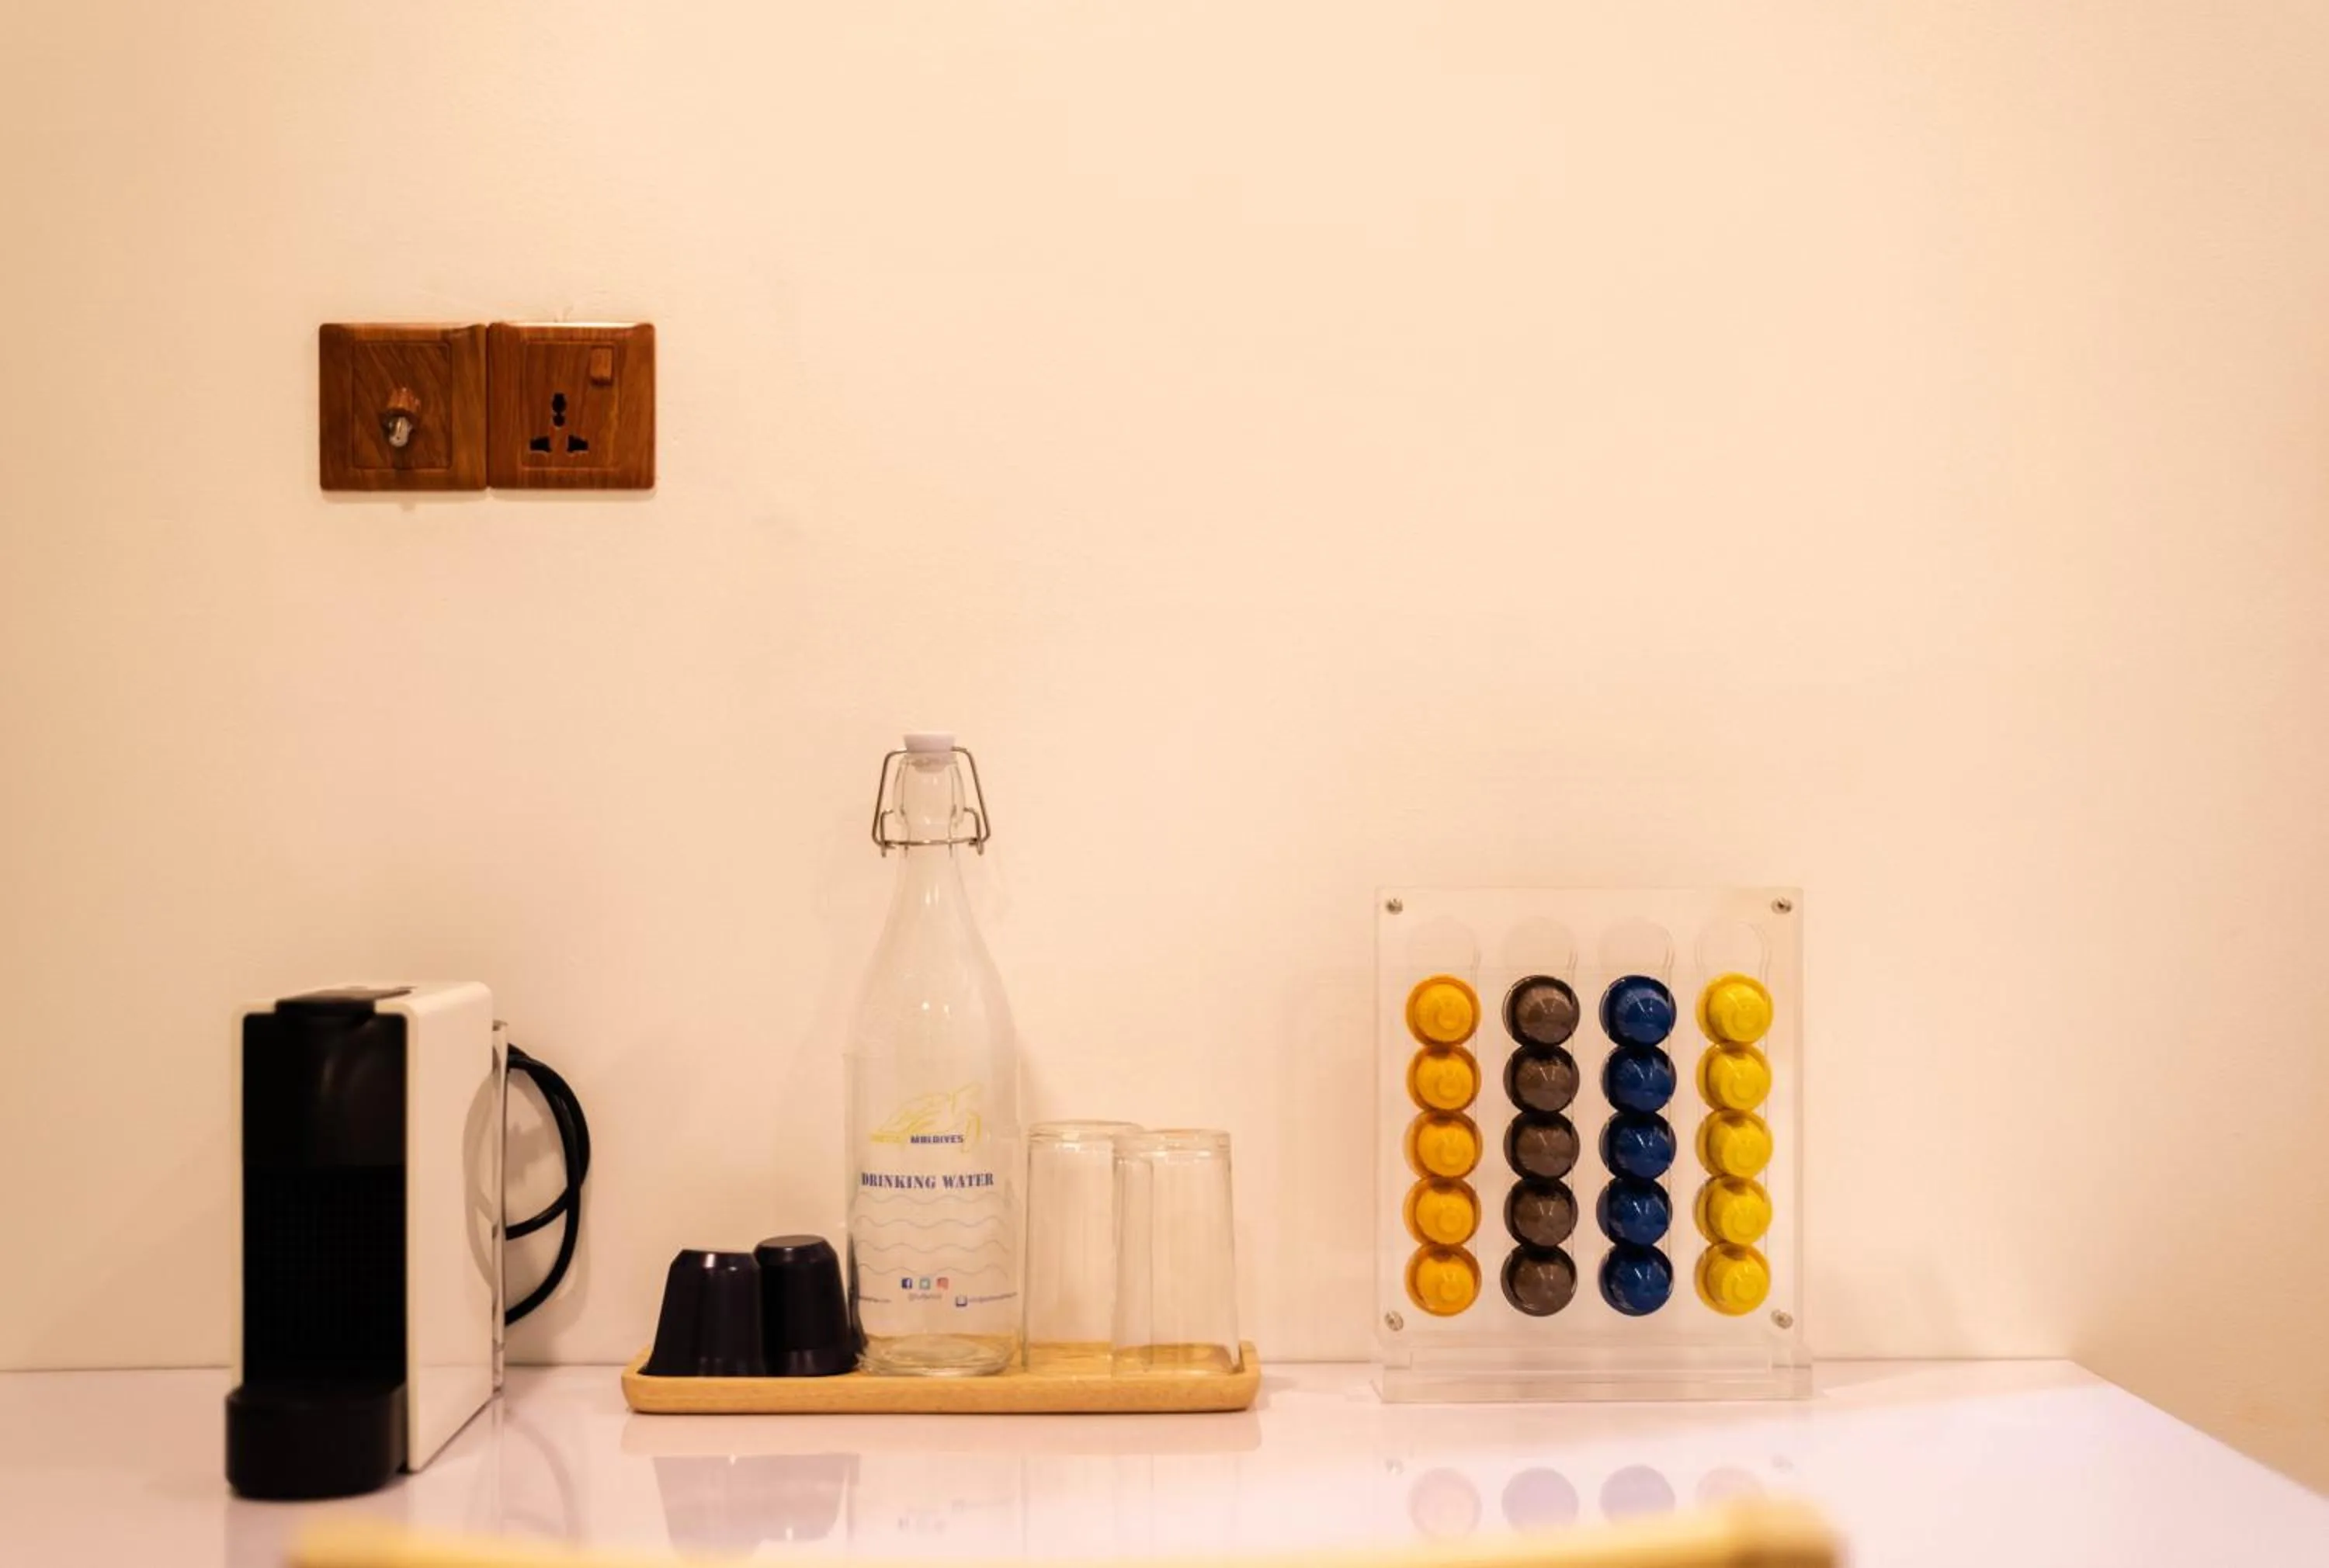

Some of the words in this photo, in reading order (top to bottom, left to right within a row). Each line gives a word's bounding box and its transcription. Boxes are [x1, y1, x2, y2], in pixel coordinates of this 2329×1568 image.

[910, 1134, 964, 1144] MALDIVES
[861, 1172, 936, 1189] DRINKING
[942, 1173, 994, 1188] WATER
